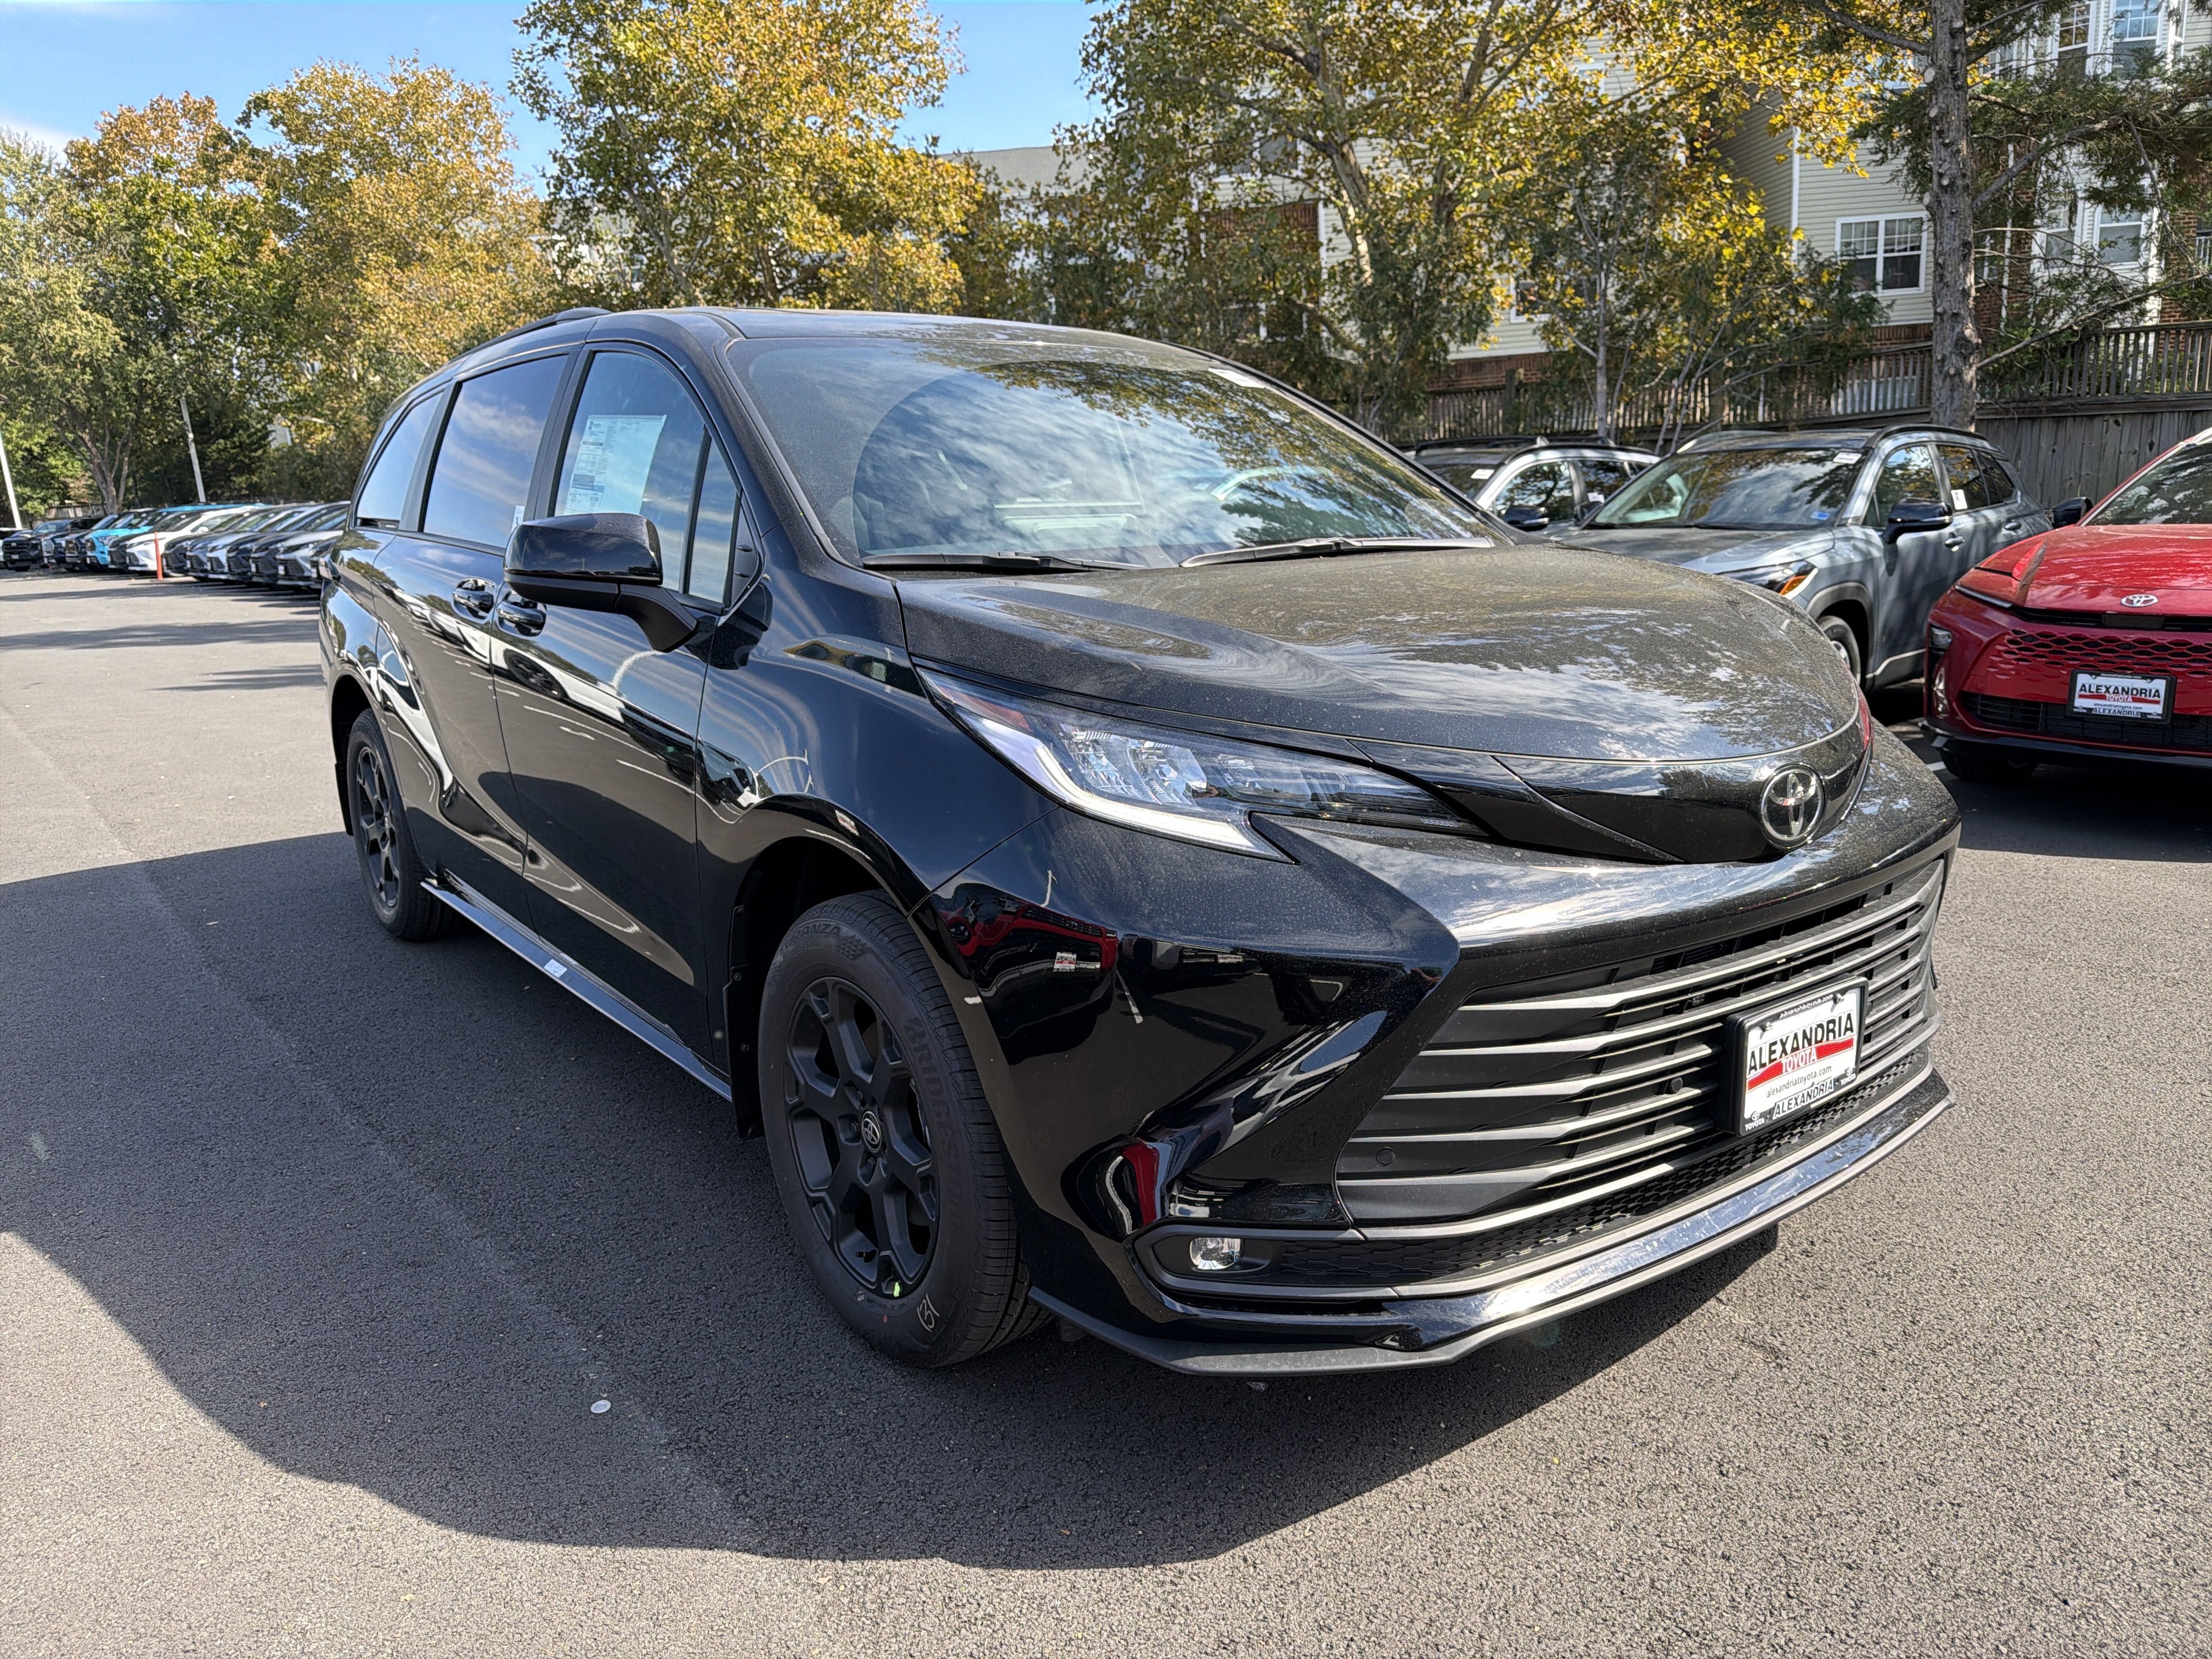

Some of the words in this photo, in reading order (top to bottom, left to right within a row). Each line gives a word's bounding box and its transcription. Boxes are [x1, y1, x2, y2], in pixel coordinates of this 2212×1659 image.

[2078, 684, 2161, 699] ALEXANDRIA
[2106, 694, 2133, 703] TOYOTA
[2093, 707, 2140, 717] ALEXANDRIA
[1748, 1013, 1854, 1076] ALEXANDRIA
[1781, 1047, 1818, 1074] TOYOTA
[1767, 1065, 1832, 1098] alexandriatoyota.com
[1774, 1078, 1833, 1118] ALEXANDRIA
[1745, 1117, 1765, 1131] TOYOTA
